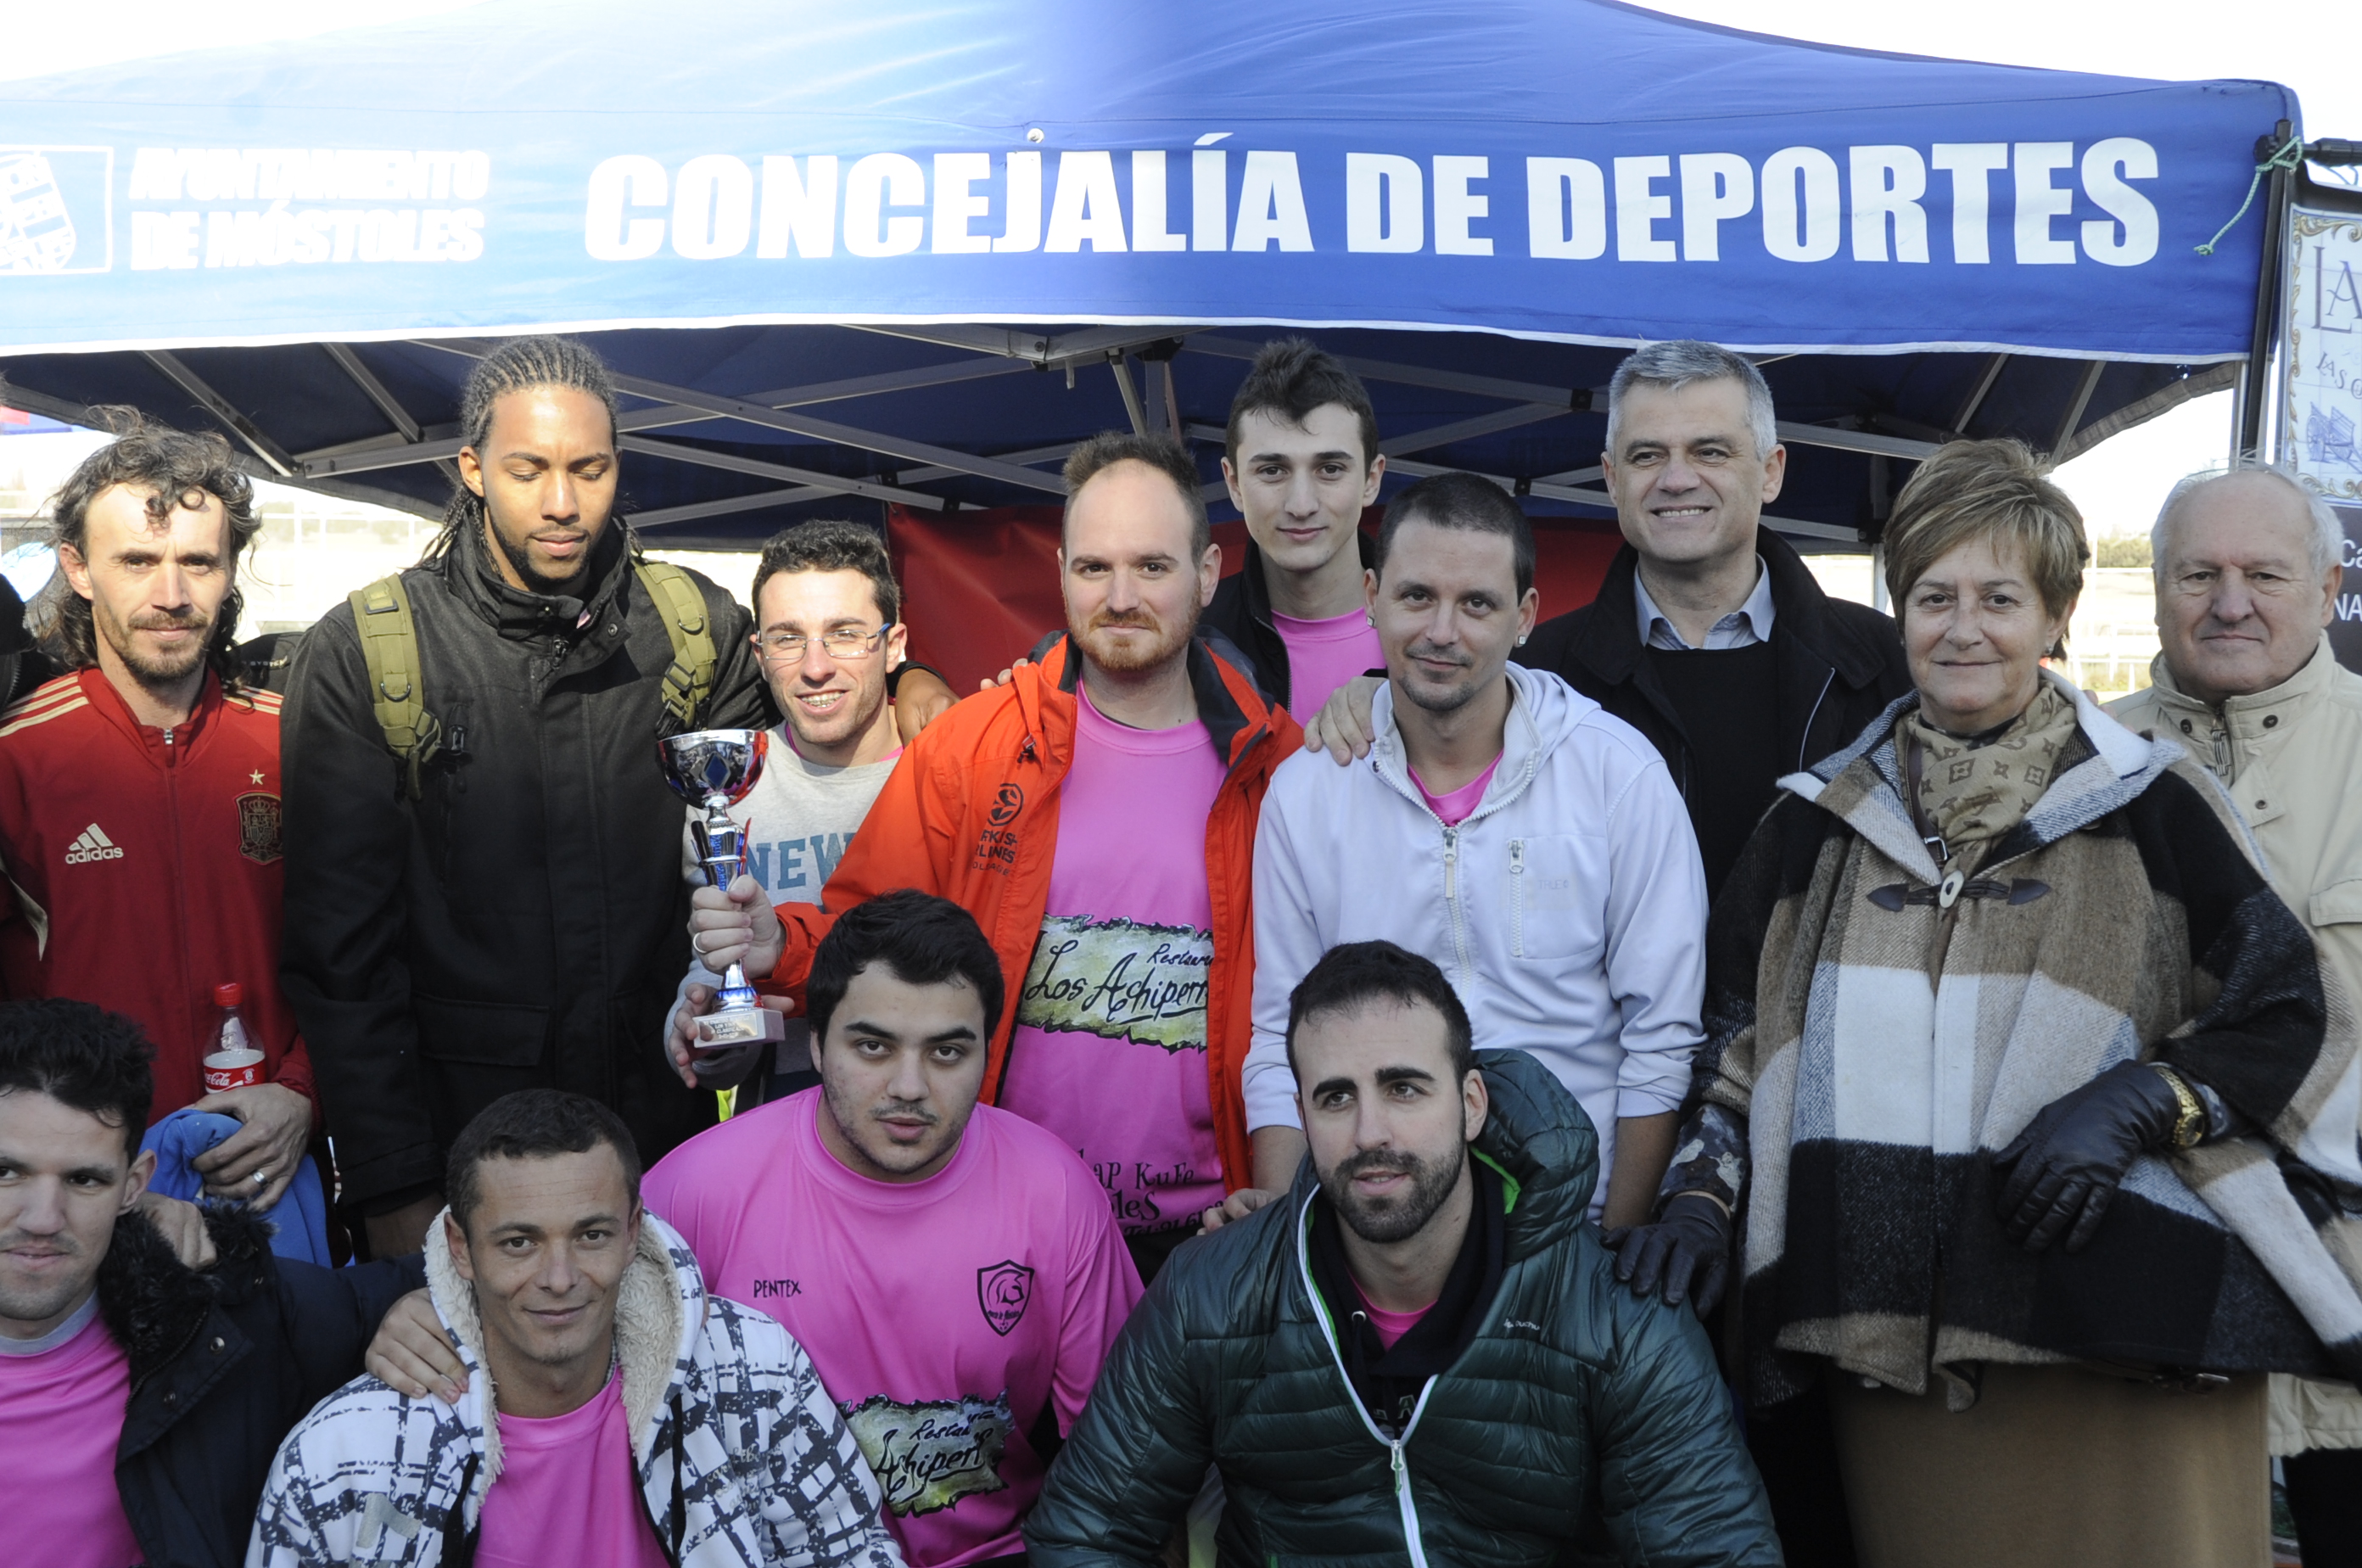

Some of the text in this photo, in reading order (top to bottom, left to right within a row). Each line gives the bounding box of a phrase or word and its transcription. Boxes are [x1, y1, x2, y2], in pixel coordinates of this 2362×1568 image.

[129, 148, 490, 201] AYUNTAMIENTO
[585, 132, 2159, 266] CONCEJALÍA DE DEPORTES
[131, 211, 201, 270] DE
[204, 199, 485, 266] MÓSTOLES
[65, 846, 124, 865] adidas
[1024, 939, 1088, 1001] Los
[753, 1279, 802, 1298] PENTEX
